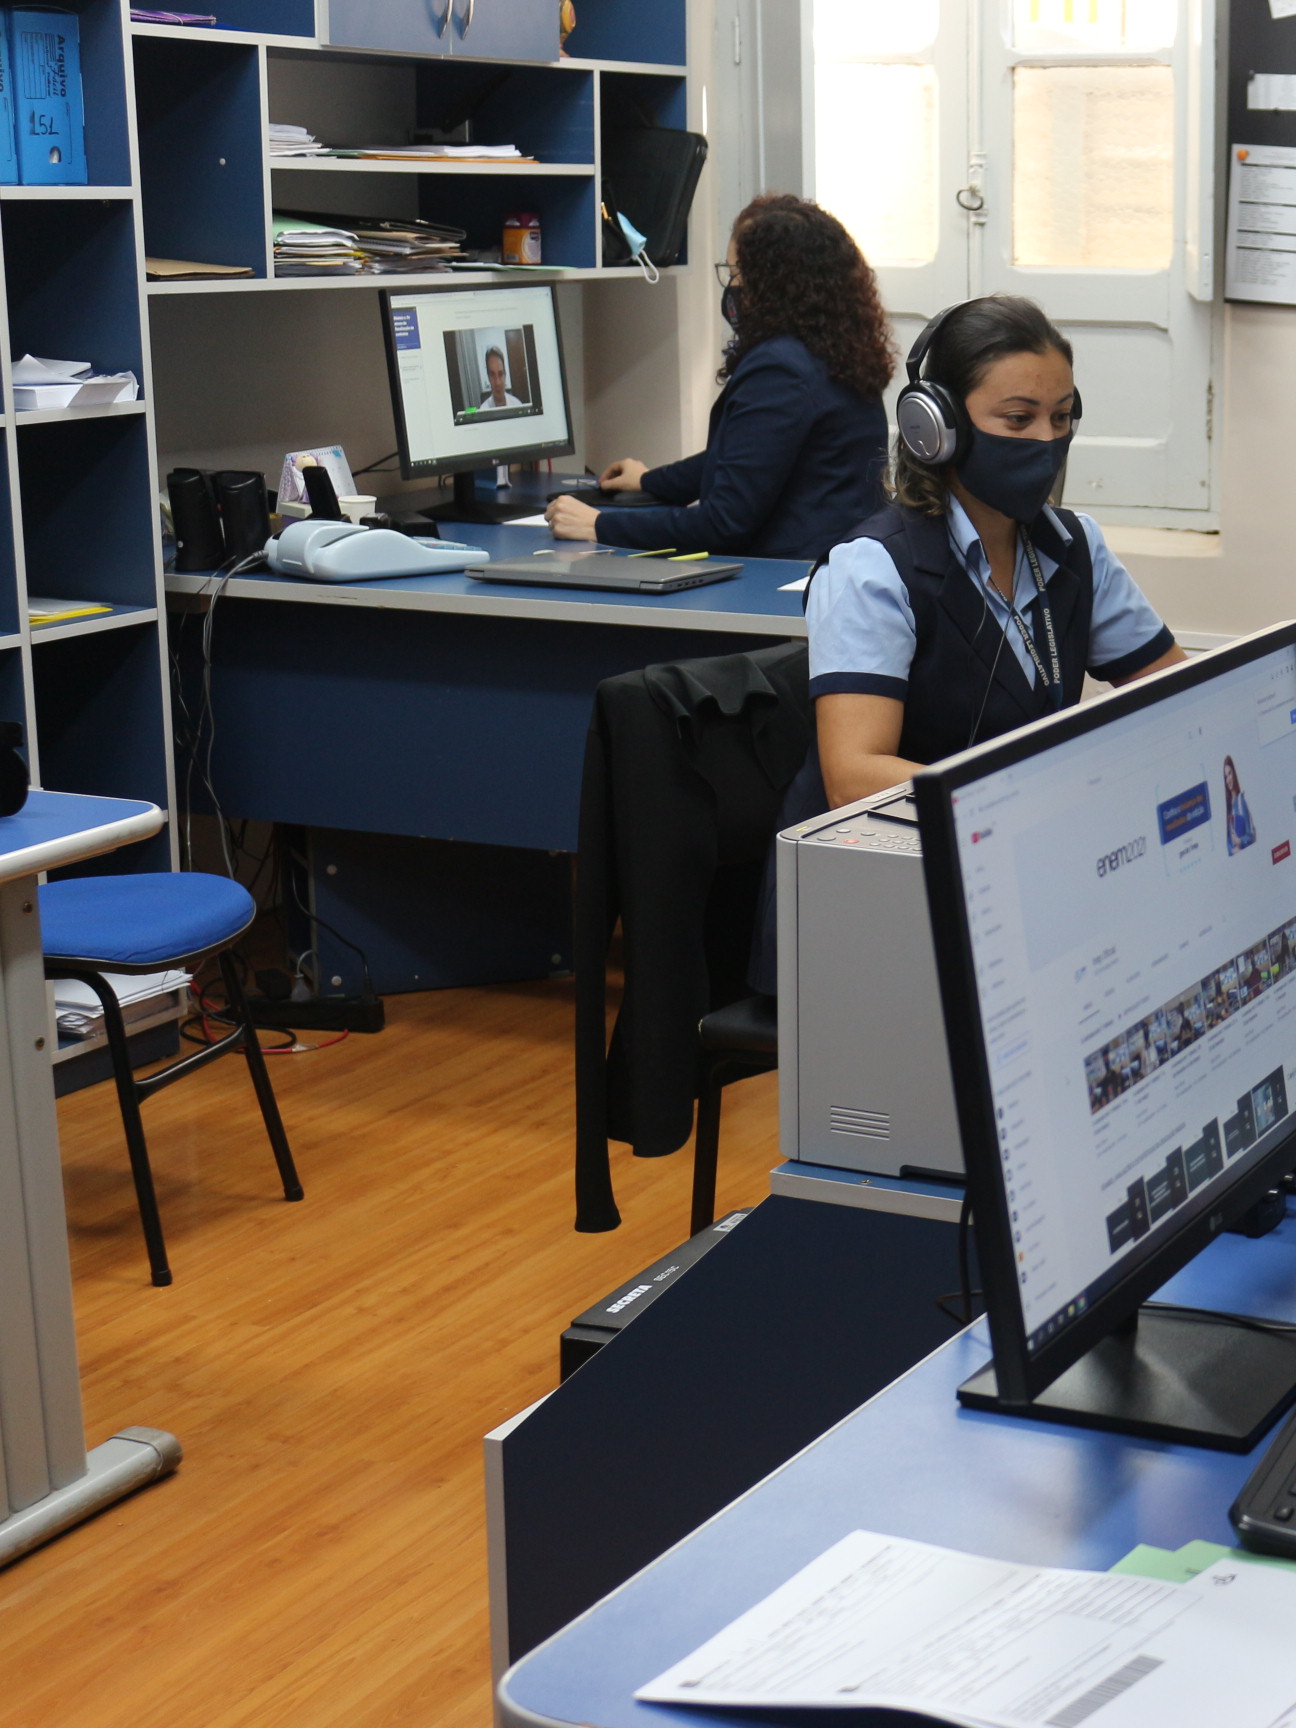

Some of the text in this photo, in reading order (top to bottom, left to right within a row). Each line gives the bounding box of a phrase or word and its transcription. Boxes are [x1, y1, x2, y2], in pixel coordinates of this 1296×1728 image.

[57, 33, 67, 97] Arquivo
[1014, 615, 1050, 686] PODER LEGISLATIVO
[1043, 608, 1061, 684] PODER LEGISLATIVO
[606, 1284, 653, 1313] SECRETA
